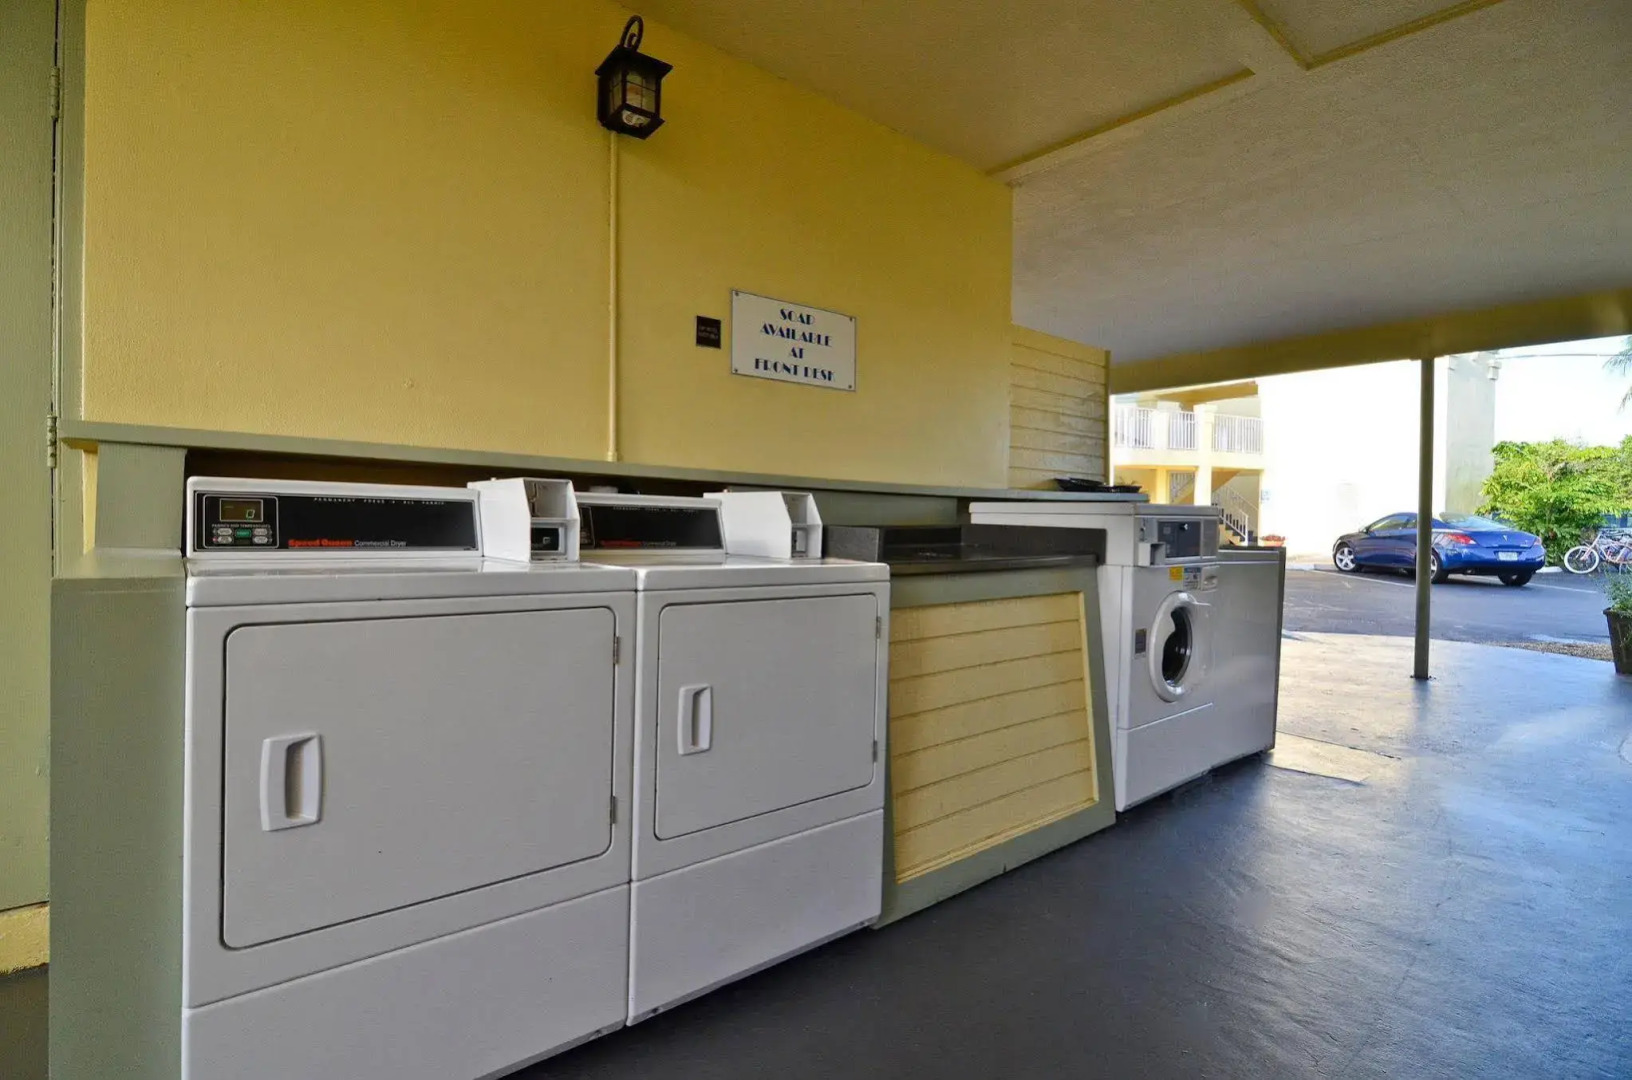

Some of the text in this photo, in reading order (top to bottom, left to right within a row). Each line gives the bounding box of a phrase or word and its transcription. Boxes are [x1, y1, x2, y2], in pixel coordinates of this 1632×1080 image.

[780, 308, 815, 326] SOAP
[760, 322, 832, 347] AVAILABLE
[788, 347, 804, 359] AT
[754, 358, 836, 382] FRONT DESK
